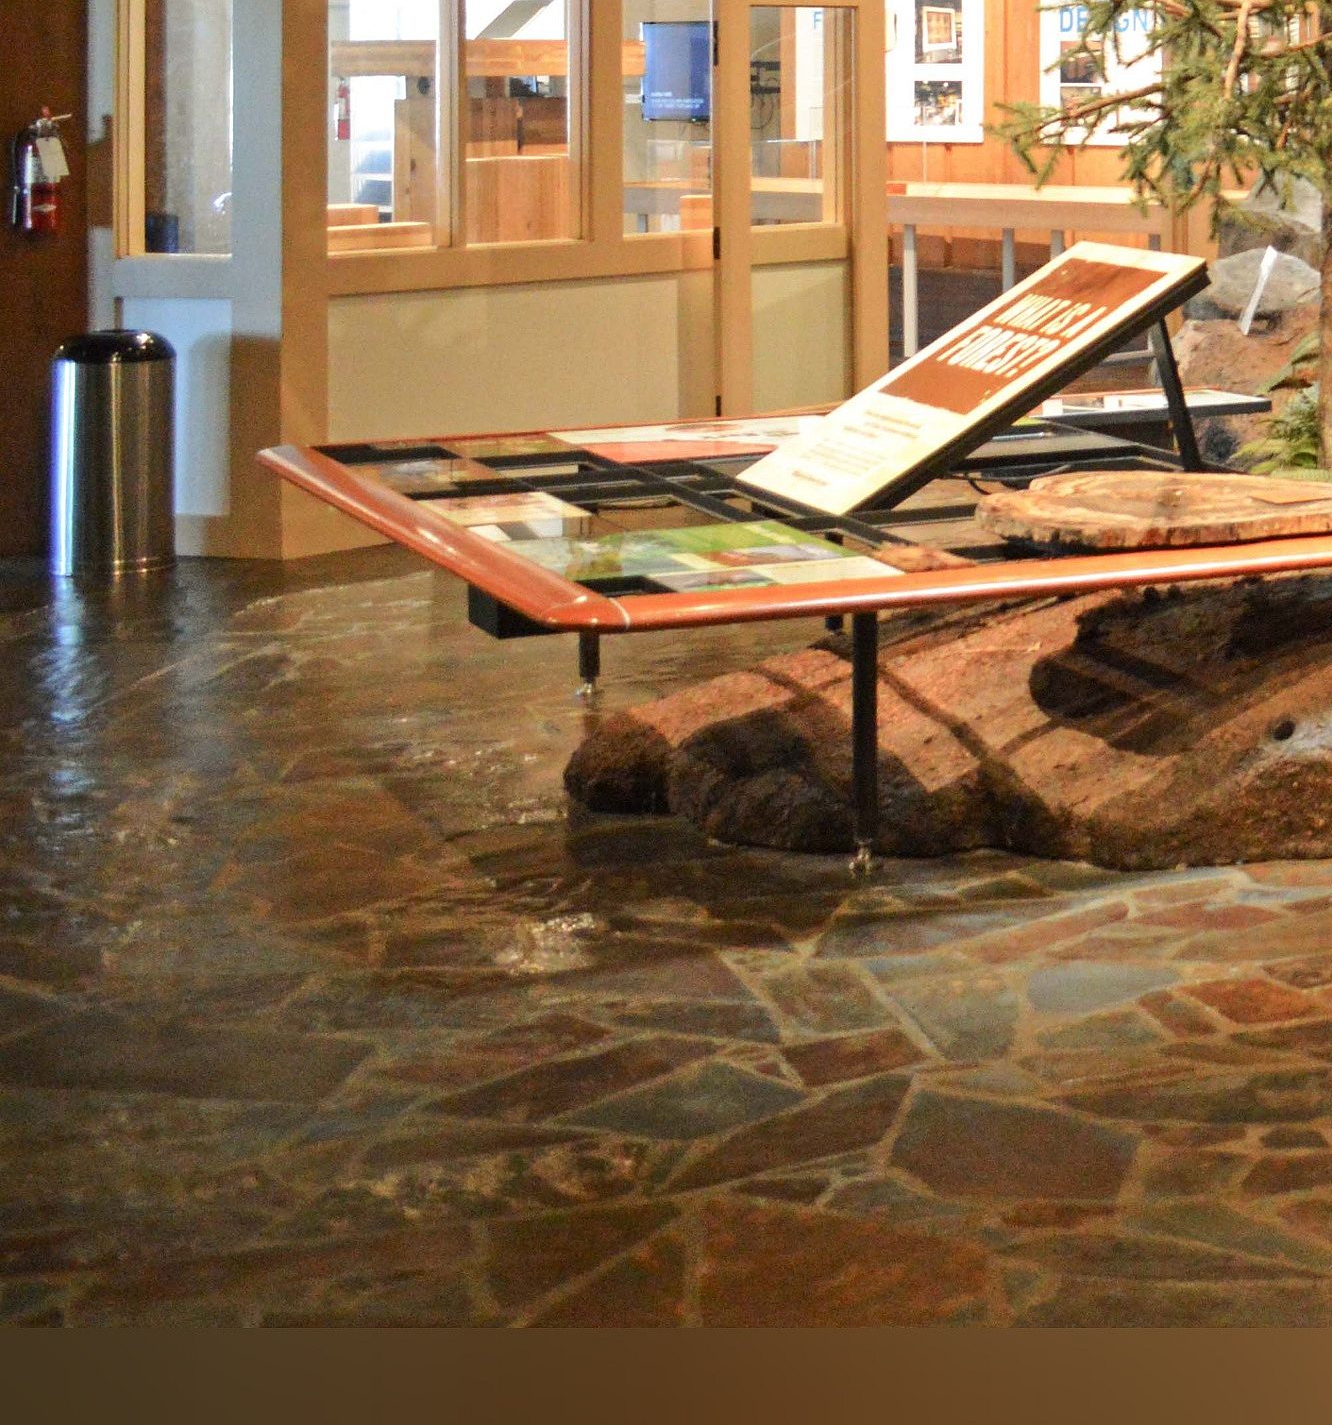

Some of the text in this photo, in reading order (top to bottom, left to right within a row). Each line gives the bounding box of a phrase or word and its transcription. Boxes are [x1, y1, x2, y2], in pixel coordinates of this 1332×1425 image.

[1059, 5, 1148, 33] DEGN
[993, 293, 1108, 338] WHAT IS A
[936, 325, 1061, 378] FOREST?
